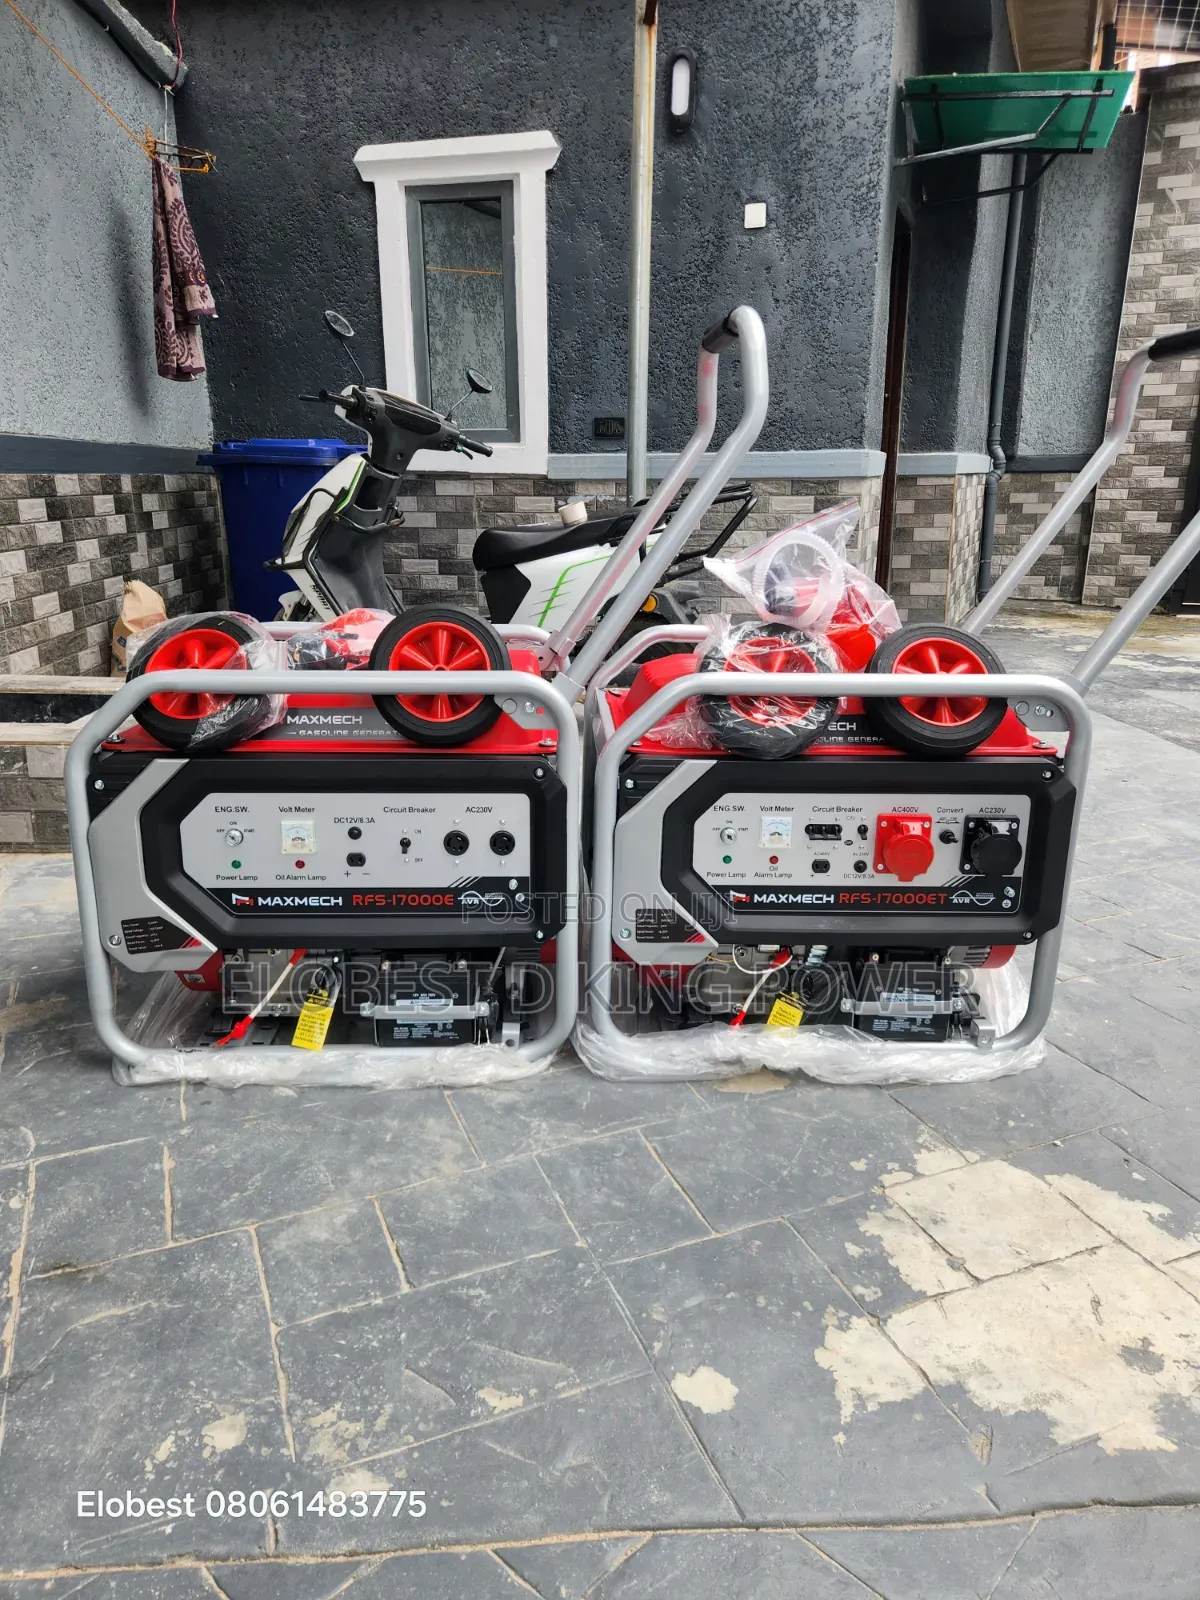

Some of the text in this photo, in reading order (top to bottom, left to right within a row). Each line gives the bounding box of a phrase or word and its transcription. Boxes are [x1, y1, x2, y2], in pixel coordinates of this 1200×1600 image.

[287, 715, 363, 725] MAXMECH
[258, 896, 343, 906] MAXMECH
[753, 894, 835, 904] MAXMECH
